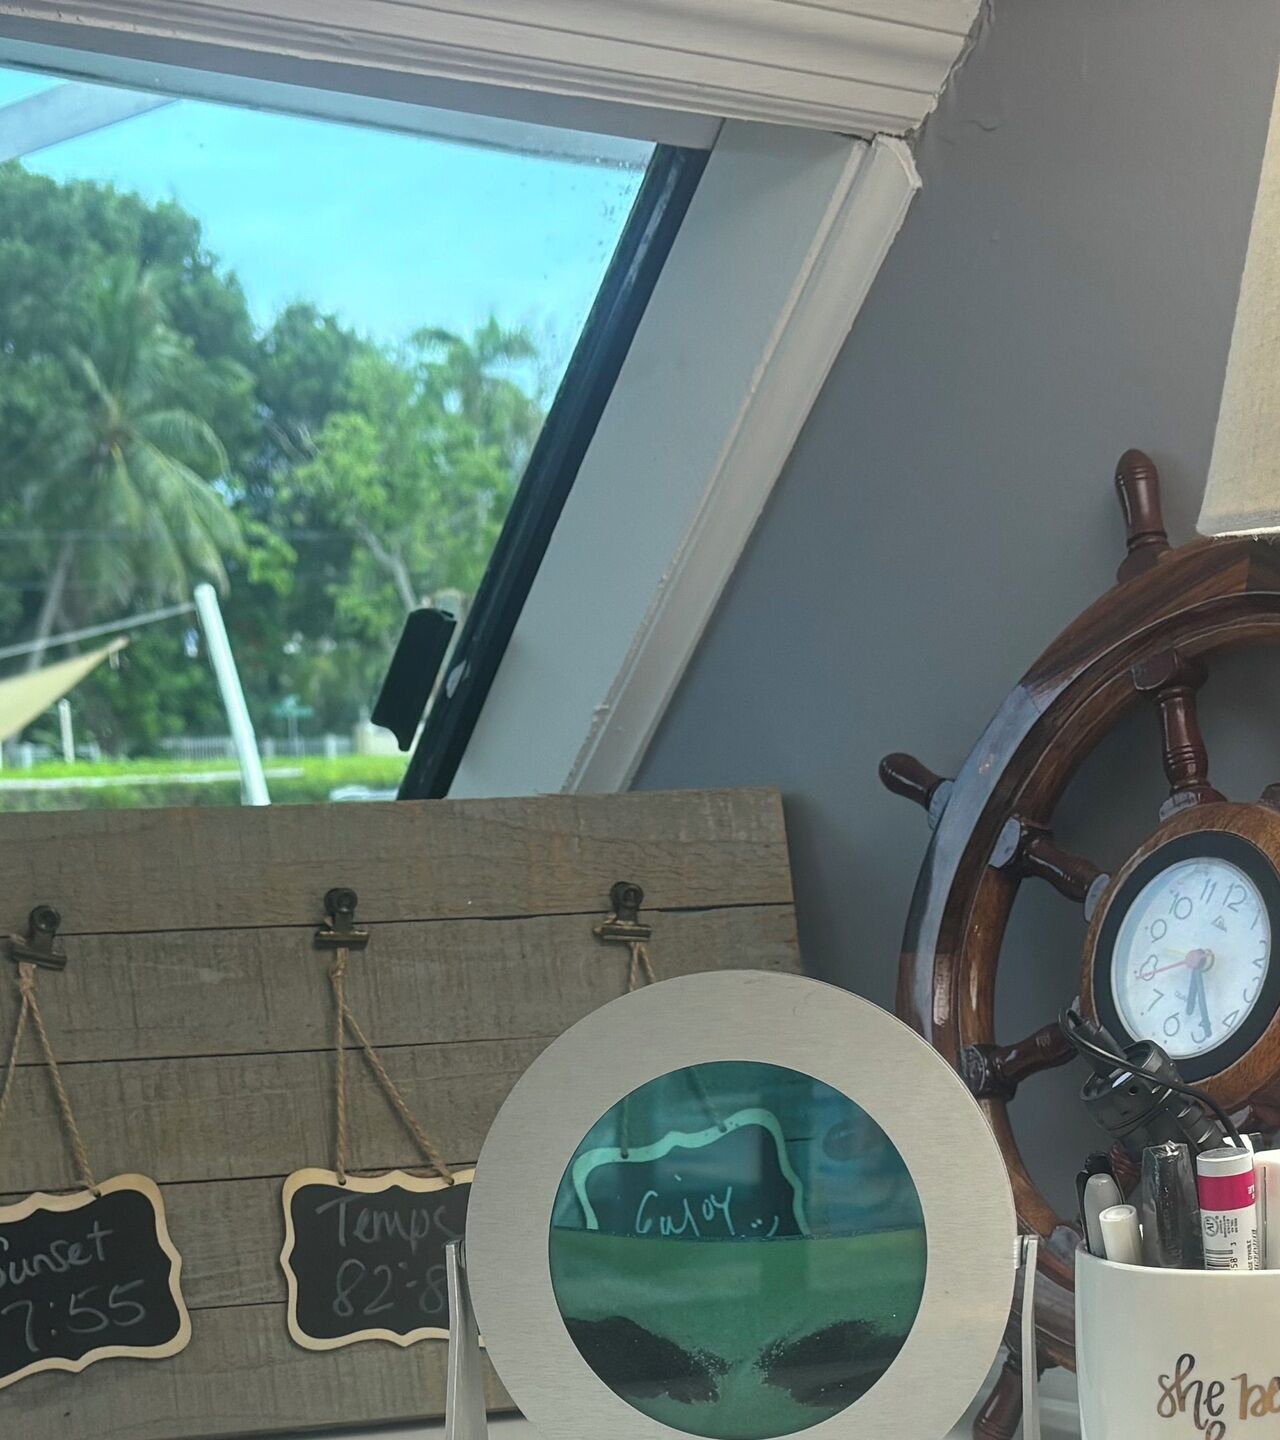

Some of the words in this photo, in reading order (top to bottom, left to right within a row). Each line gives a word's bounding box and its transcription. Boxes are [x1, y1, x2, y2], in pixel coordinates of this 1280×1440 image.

[1169, 891, 1193, 920] 10
[1200, 878, 1217, 905] 11
[1223, 878, 1247, 912] 12
[1150, 918, 1167, 943] 9
[1139, 954, 1158, 982] 8
[1252, 940, 1267, 968] 2
[1147, 988, 1165, 1012] 7
[1163, 1013, 1180, 1037] 6
[1222, 1009, 1239, 1028] 4
[1, 1279, 145, 1353] 7:55
[1156, 1353, 1225, 1430] she
